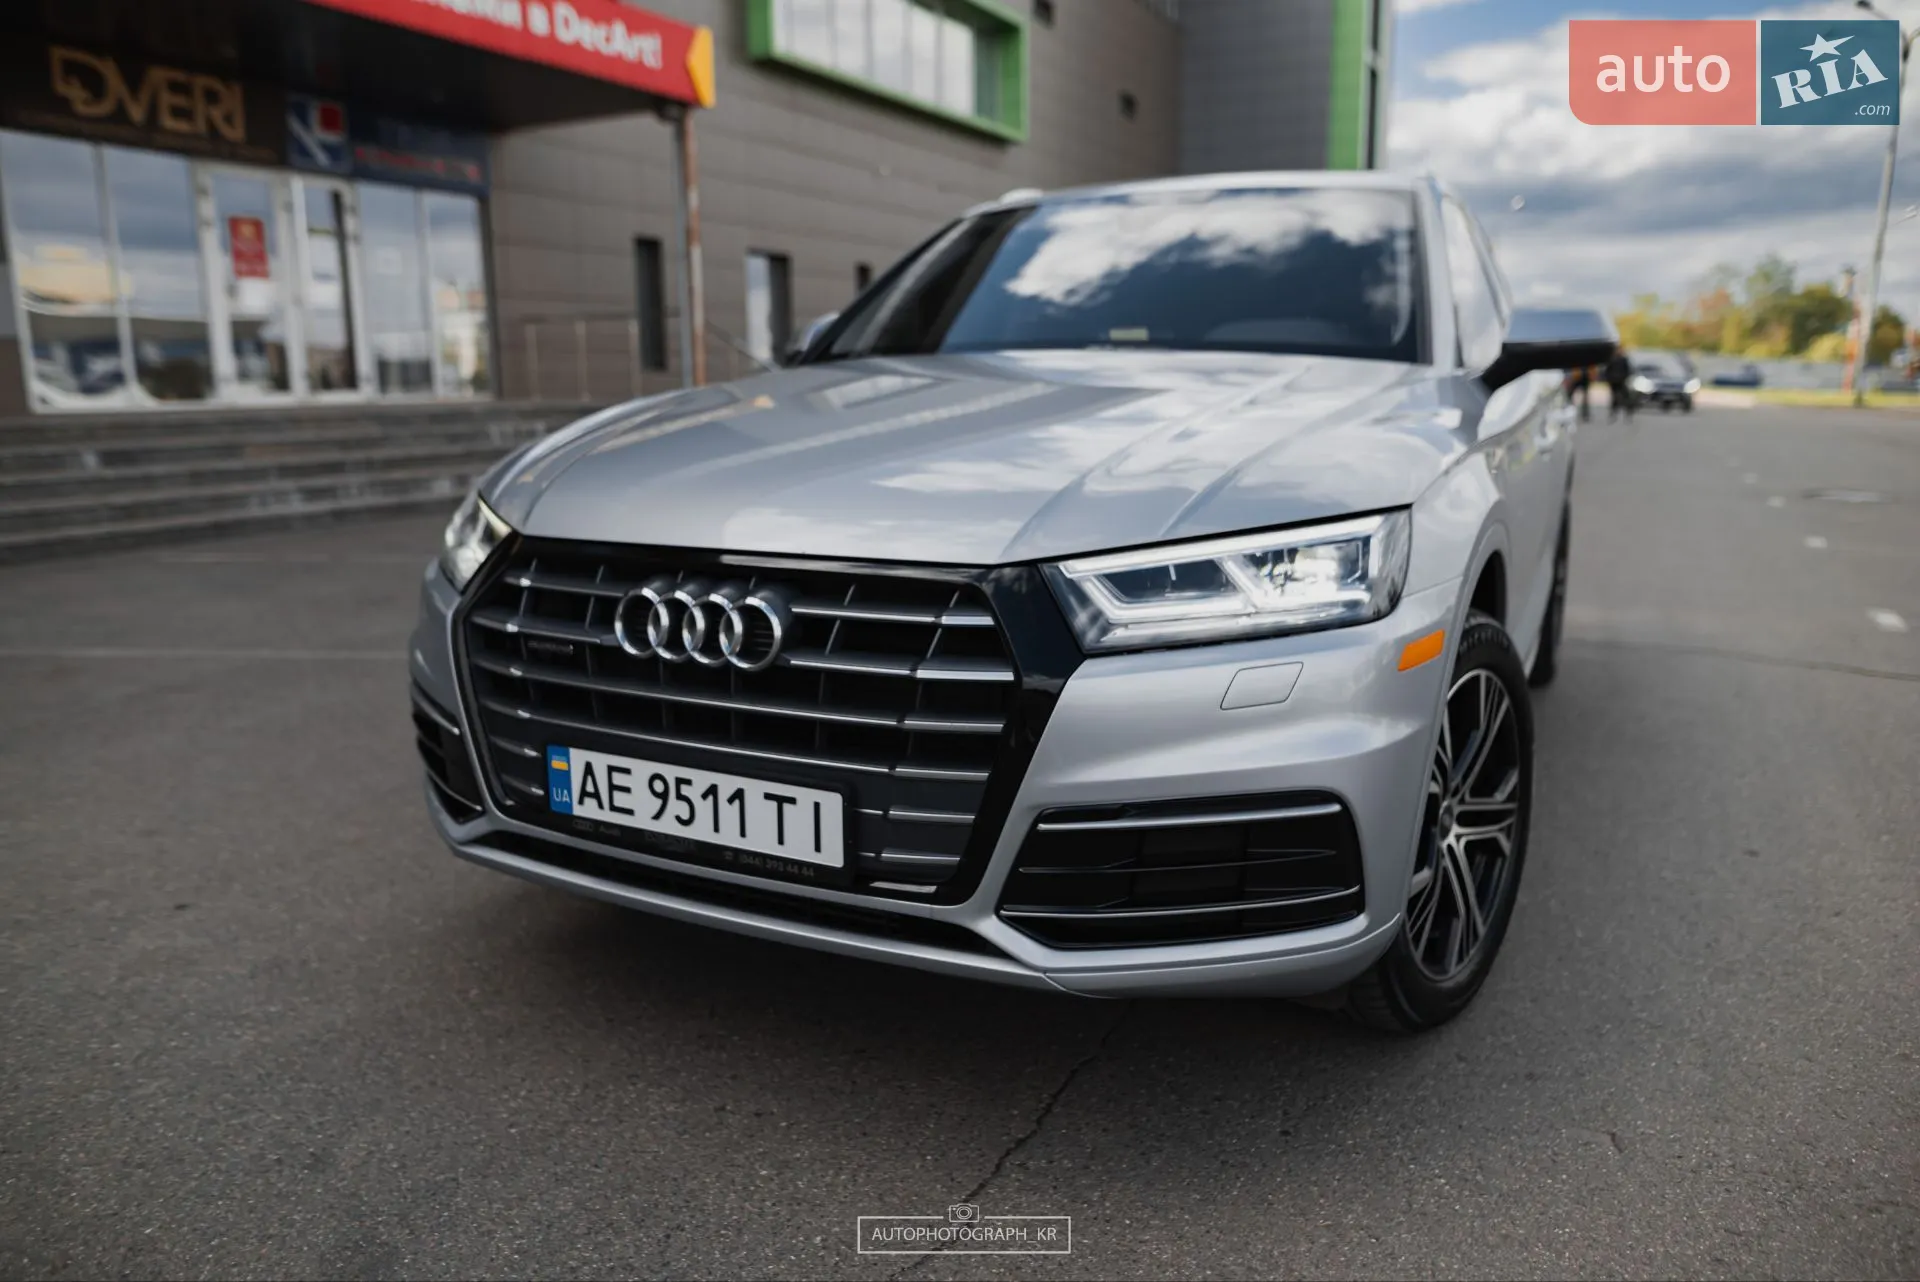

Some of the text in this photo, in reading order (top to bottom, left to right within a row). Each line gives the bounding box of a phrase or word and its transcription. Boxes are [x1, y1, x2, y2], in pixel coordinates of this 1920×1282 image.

[50, 47, 246, 143] DVERI
[552, 787, 571, 803] UA
[578, 760, 635, 816] AE
[648, 772, 747, 838] 9511
[763, 791, 822, 853] TI
